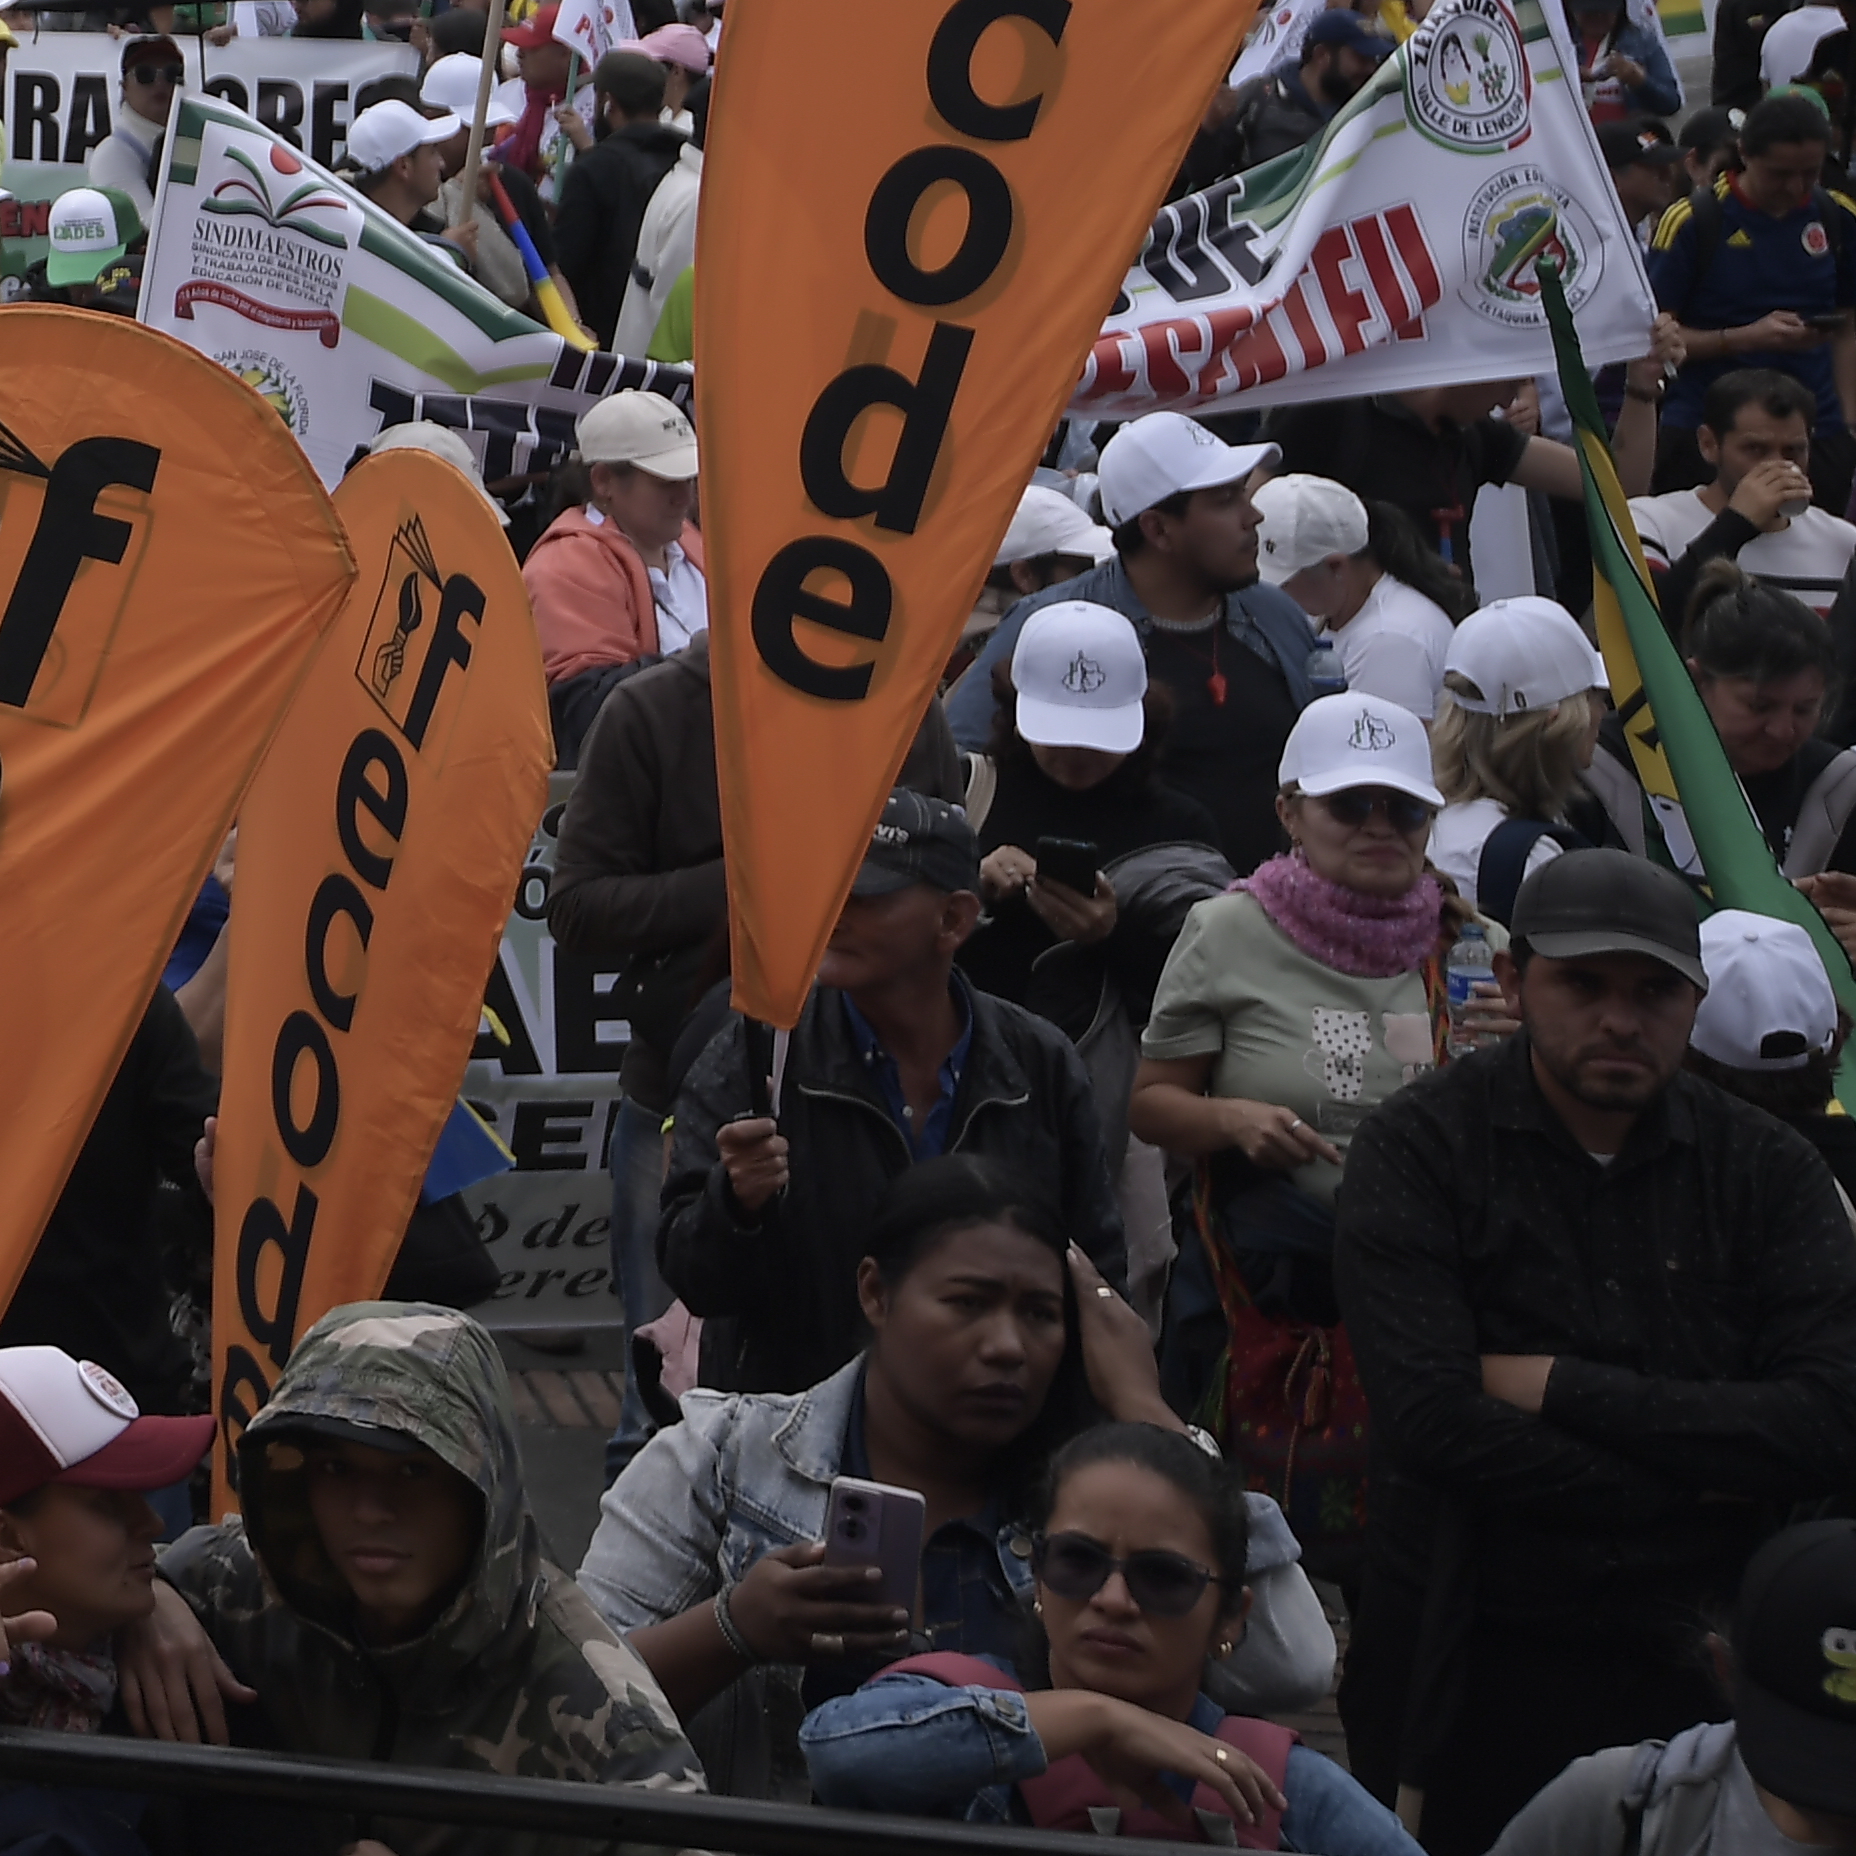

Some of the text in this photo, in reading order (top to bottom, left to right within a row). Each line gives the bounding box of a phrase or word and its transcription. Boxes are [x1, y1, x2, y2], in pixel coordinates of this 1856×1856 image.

[1416, 84, 1450, 128] VALLE
[1452, 120, 1474, 137] DE
[191, 241, 338, 291] SINDICATO DE MAESTROS
[194, 217, 343, 280] SINDIMAESTROS
[191, 266, 263, 286] EDUCACIÓN
[266, 278, 283, 291] DE
[192, 254, 334, 300] Y TRABAJADORES DE LA
[240, 349, 268, 363] JOSE
[269, 355, 284, 373] DE
[291, 384, 310, 436] FLORIDA
